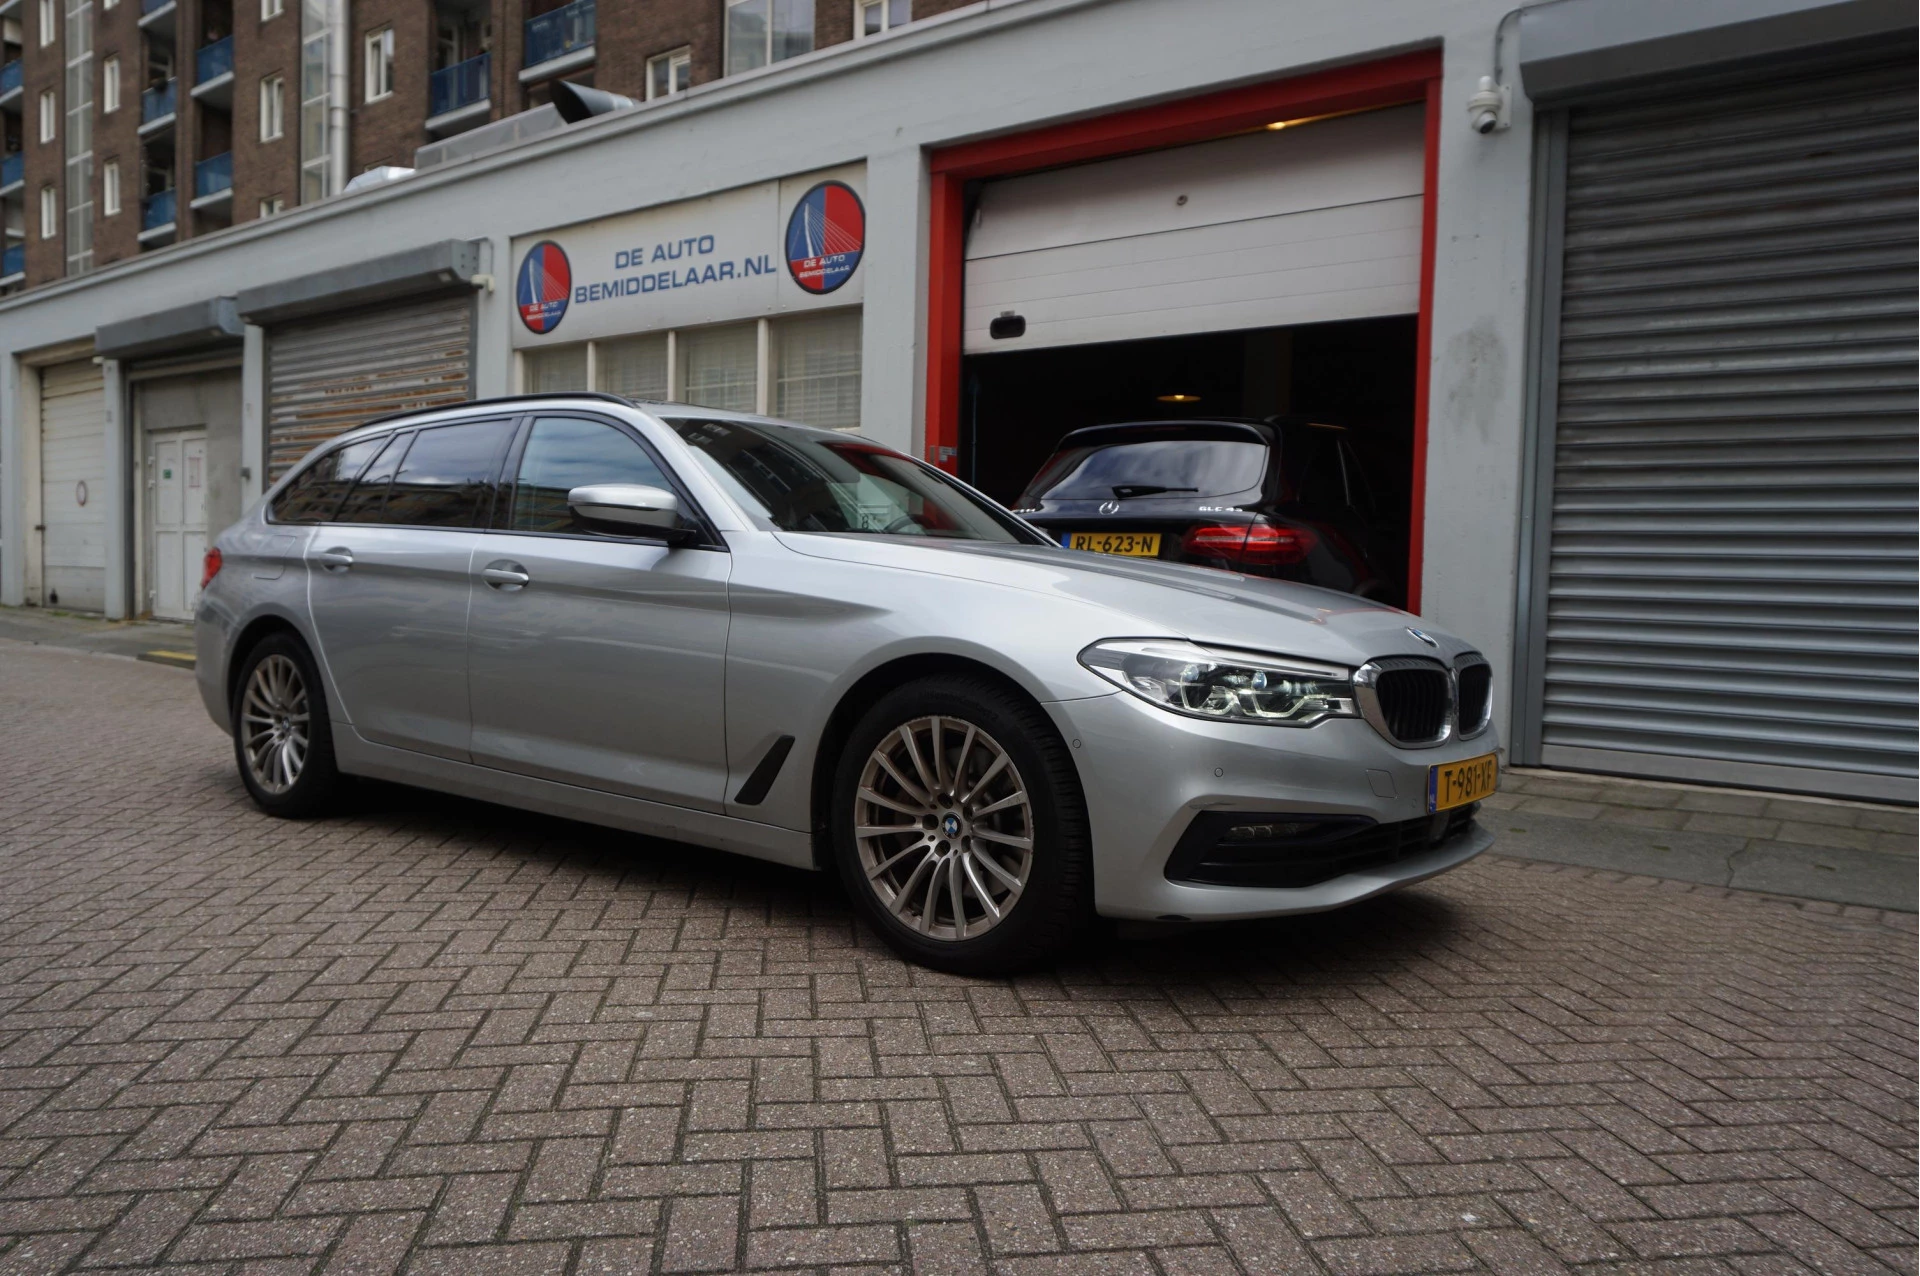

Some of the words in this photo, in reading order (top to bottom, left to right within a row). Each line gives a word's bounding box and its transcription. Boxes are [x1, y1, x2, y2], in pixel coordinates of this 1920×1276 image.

[615, 247, 644, 269] DE
[651, 234, 715, 263] AUTO
[803, 259, 817, 268] DE
[819, 254, 845, 266] AUTO
[575, 254, 777, 304] BEMIDDELAAR.NL
[1075, 535, 1153, 553] RL-623-N
[1444, 759, 1492, 803] T-981-XF
